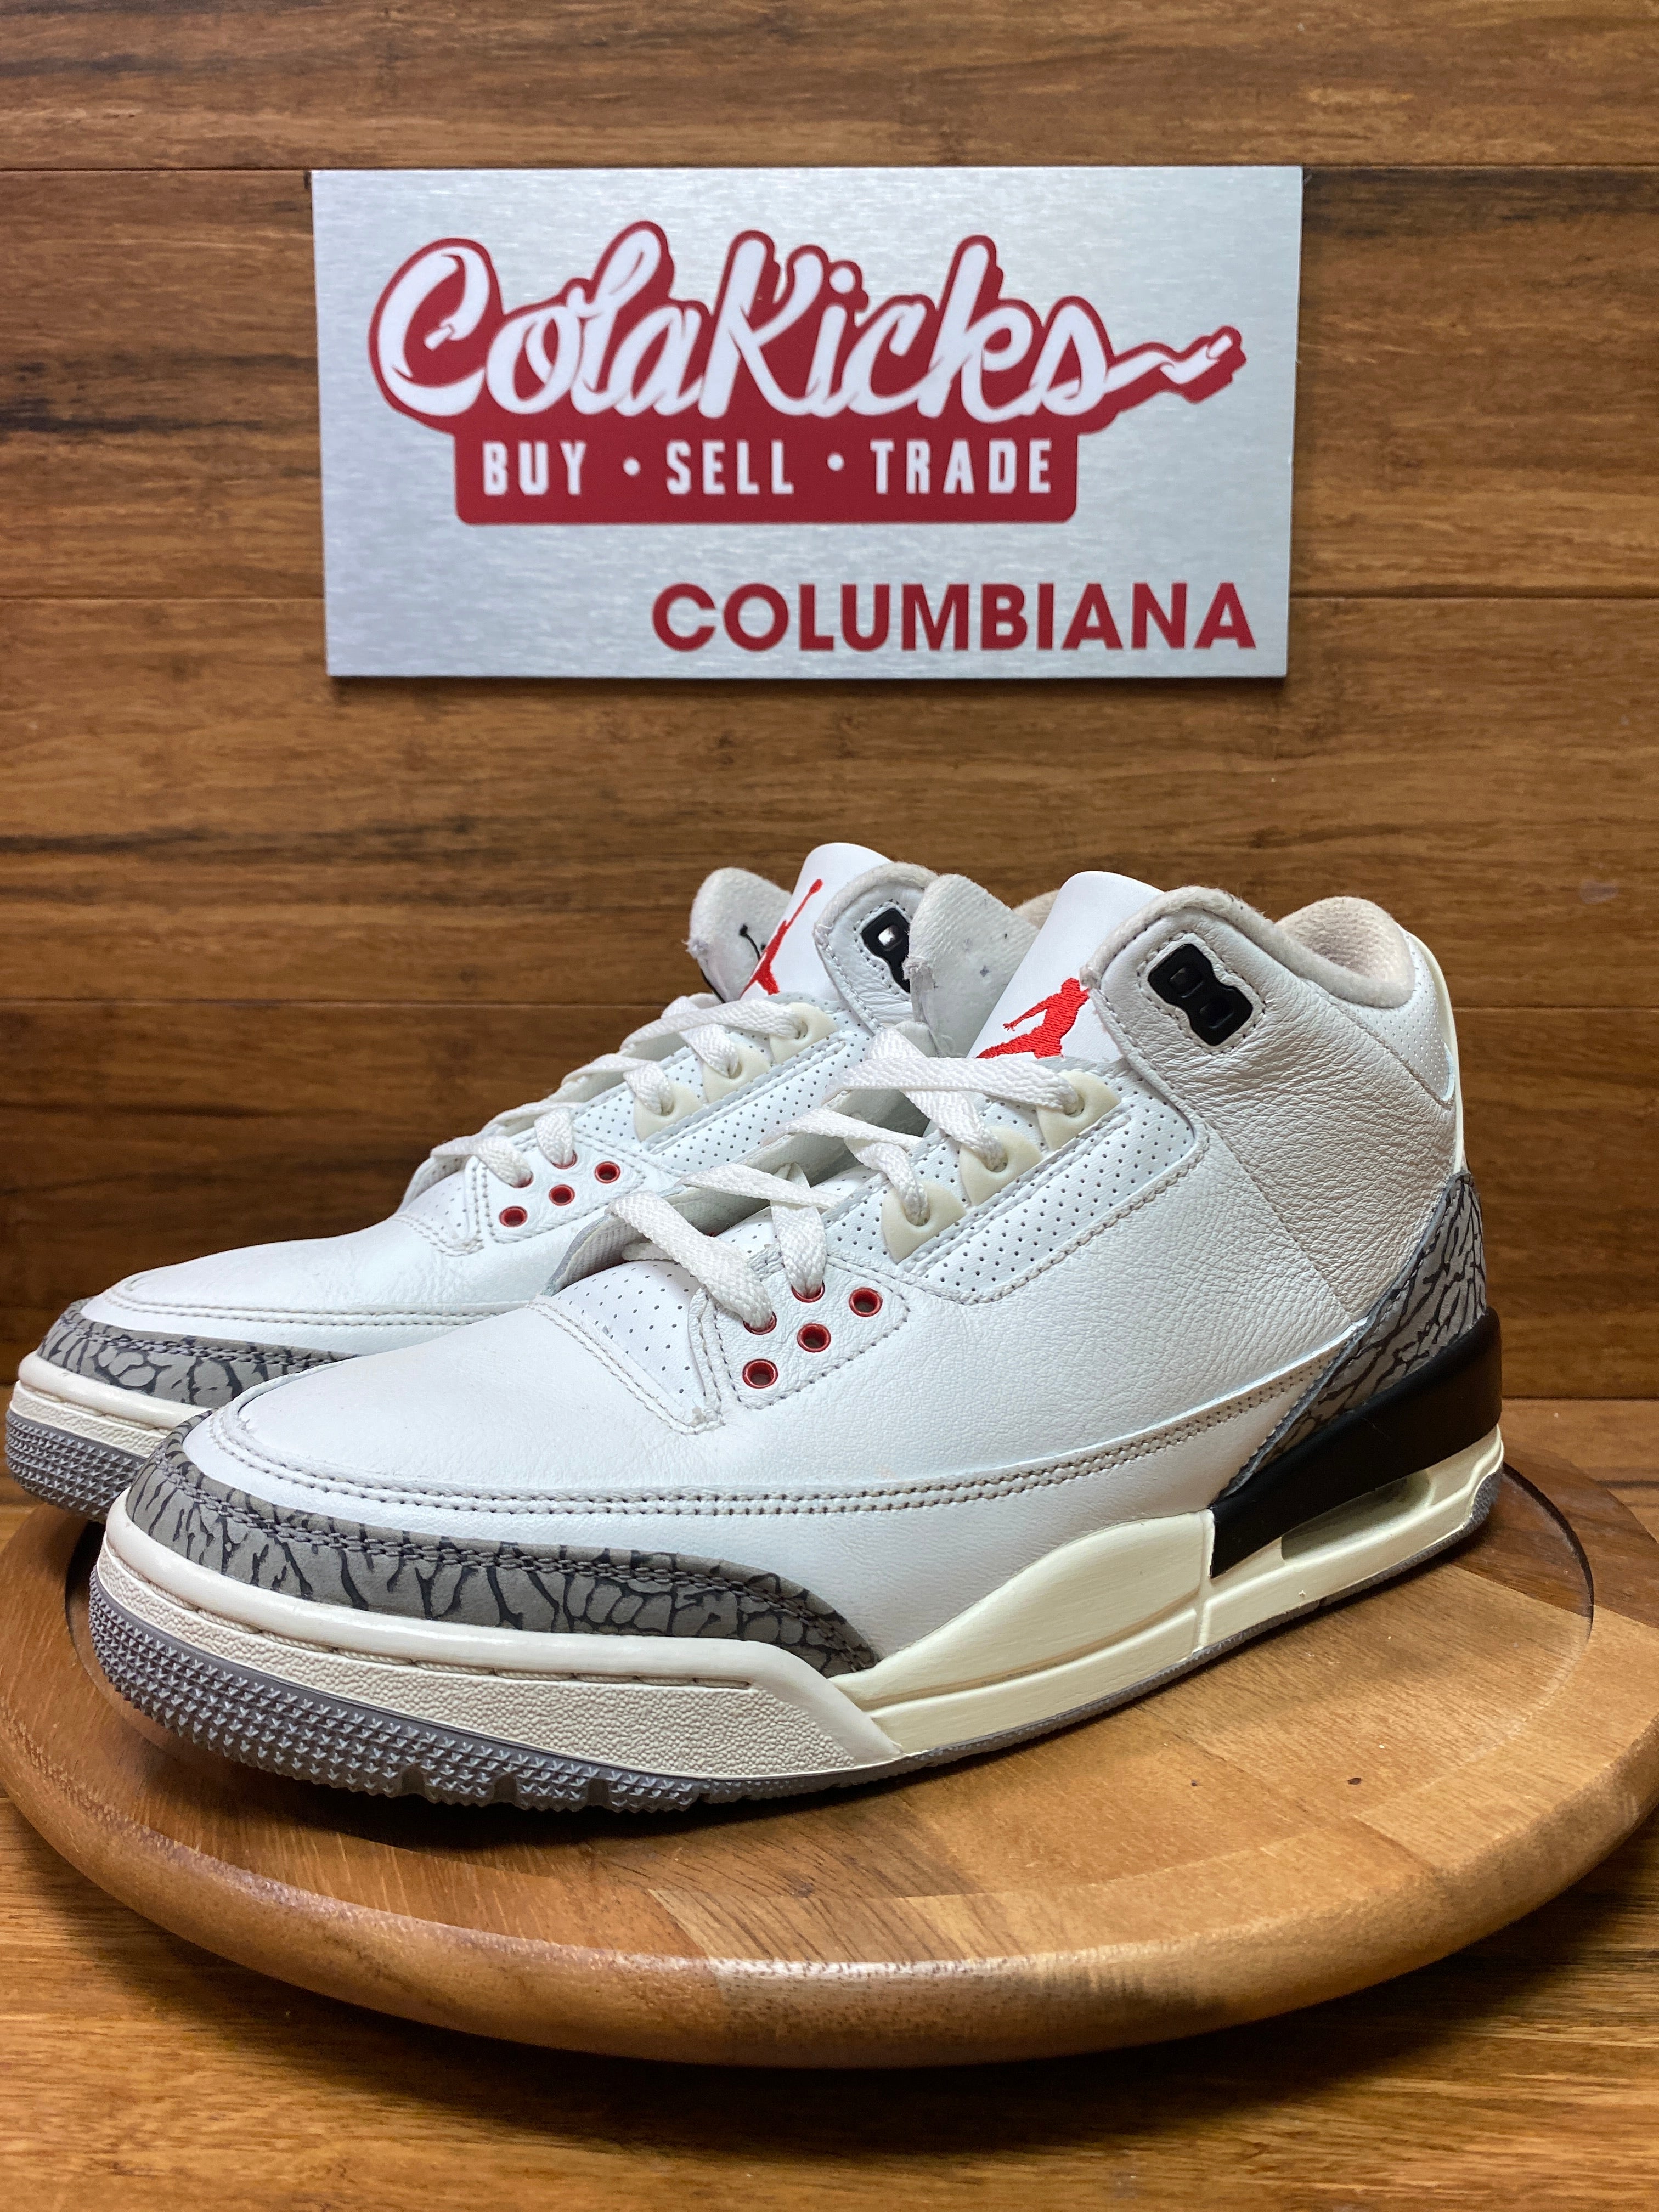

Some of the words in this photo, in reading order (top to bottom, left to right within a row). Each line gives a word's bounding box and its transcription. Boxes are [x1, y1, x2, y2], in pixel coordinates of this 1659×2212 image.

[482, 441, 587, 496] BUY
[665, 440, 794, 495] SELL
[869, 439, 1052, 494] TRADE
[652, 582, 1256, 652] COLUMBIANA
